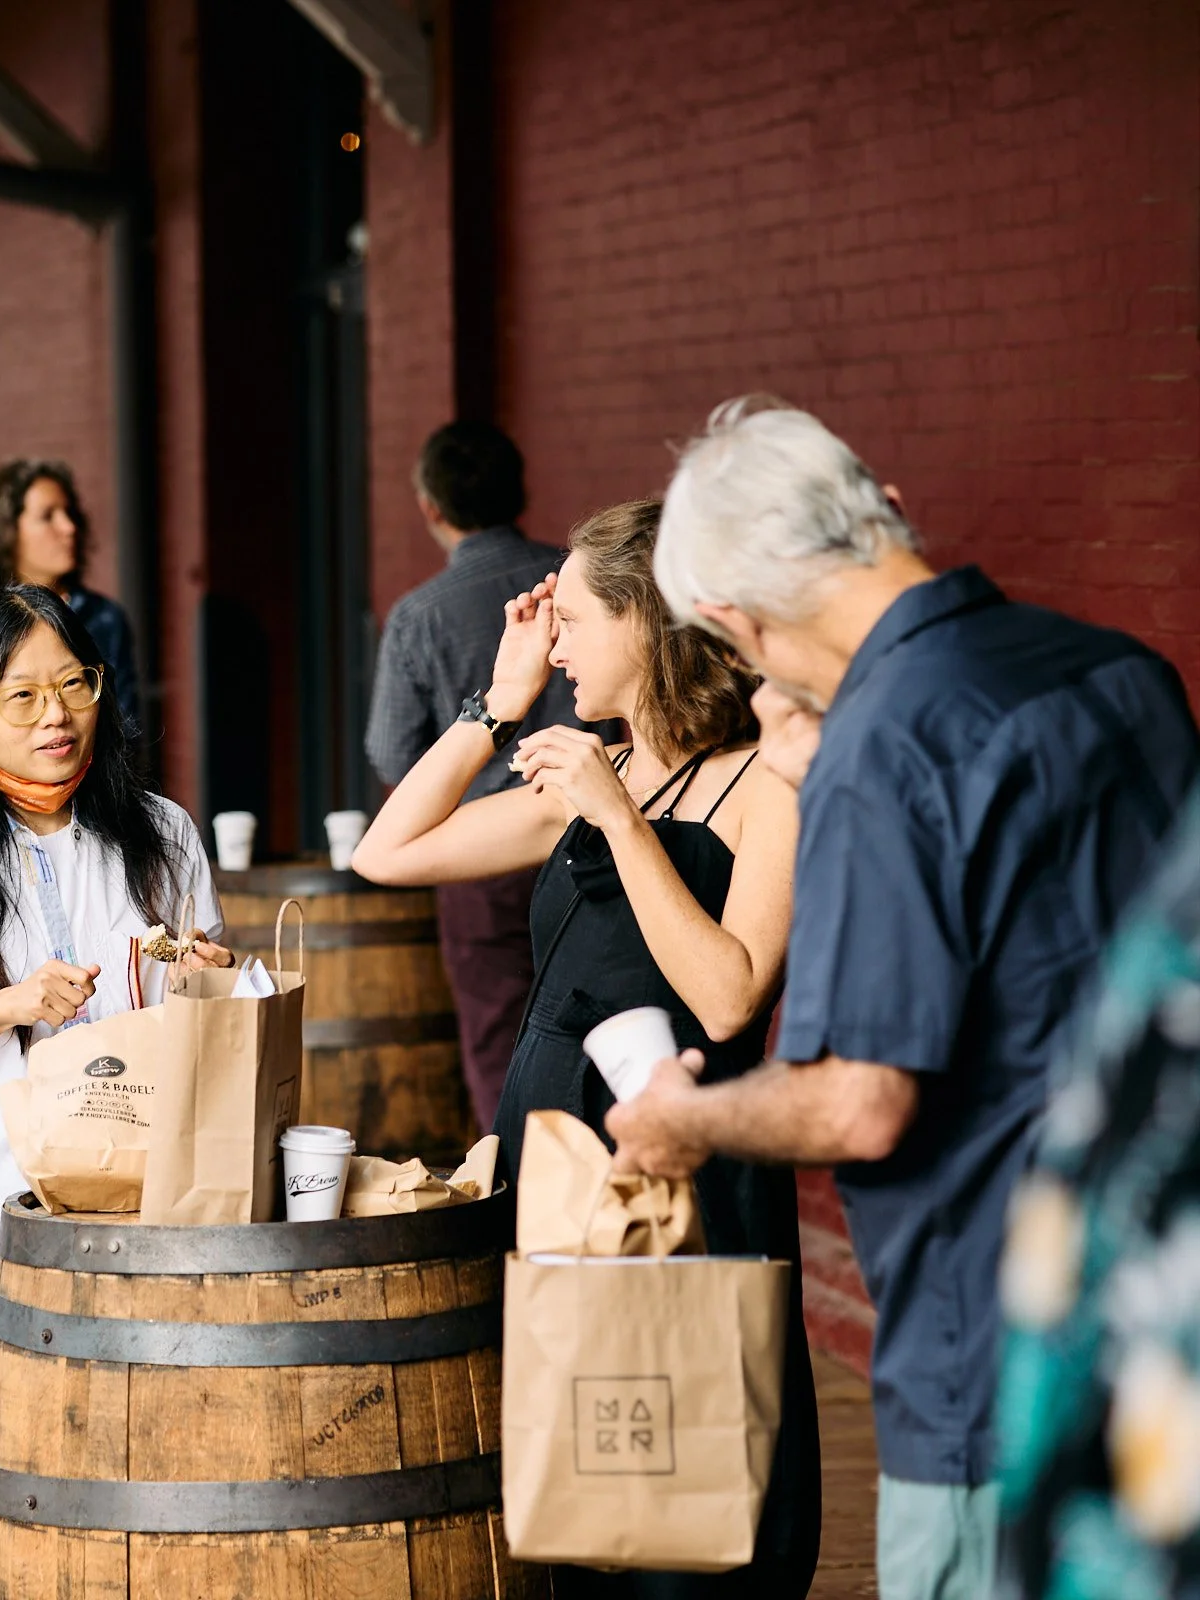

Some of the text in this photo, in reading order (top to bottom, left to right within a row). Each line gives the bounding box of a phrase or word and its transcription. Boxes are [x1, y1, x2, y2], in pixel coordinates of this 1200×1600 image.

[98, 1058, 110, 1068] K
[90, 1068, 120, 1076] brew
[57, 1081, 98, 1100] COFFEE
[102, 1081, 110, 1090] &
[288, 1173, 340, 1190] K Brew
